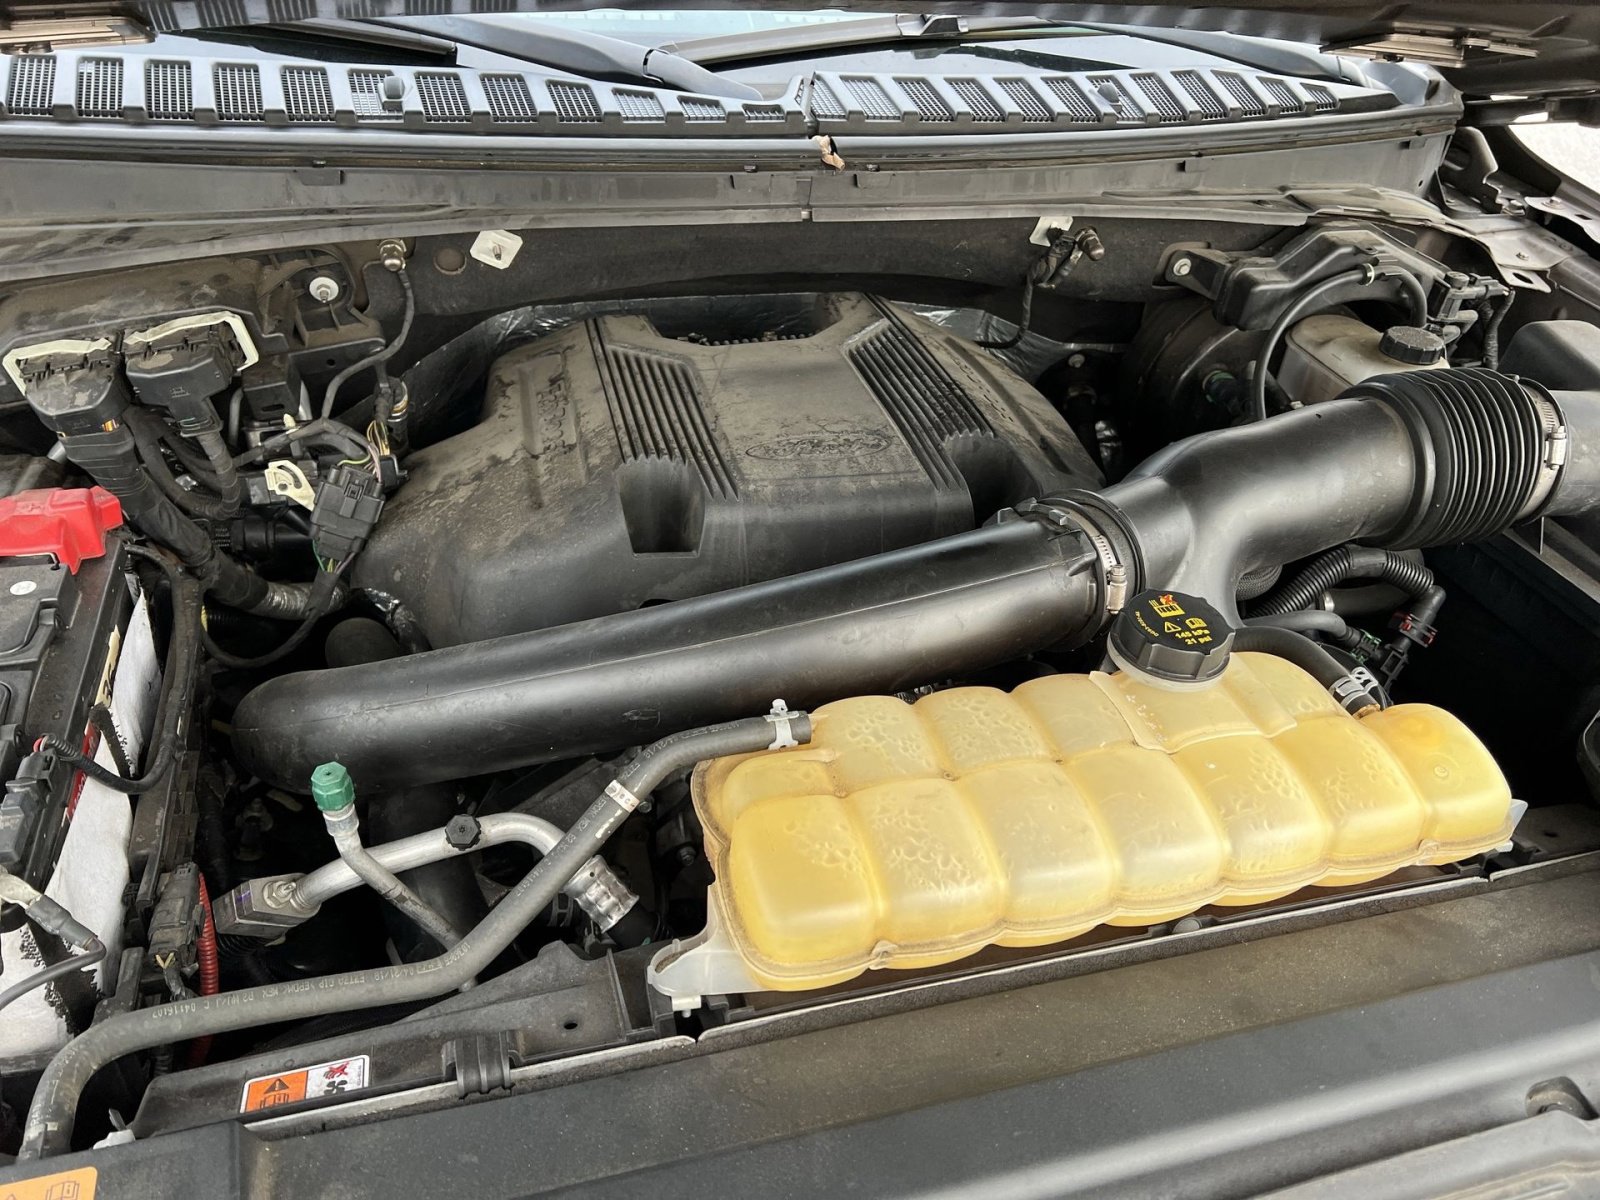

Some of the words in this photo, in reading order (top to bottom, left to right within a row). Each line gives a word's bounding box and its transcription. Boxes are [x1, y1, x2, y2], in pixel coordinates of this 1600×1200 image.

[1174, 630, 1192, 640] 145
[1191, 628, 1211, 637] kPa
[1185, 637, 1197, 646] 21
[1198, 635, 1212, 645] psi
